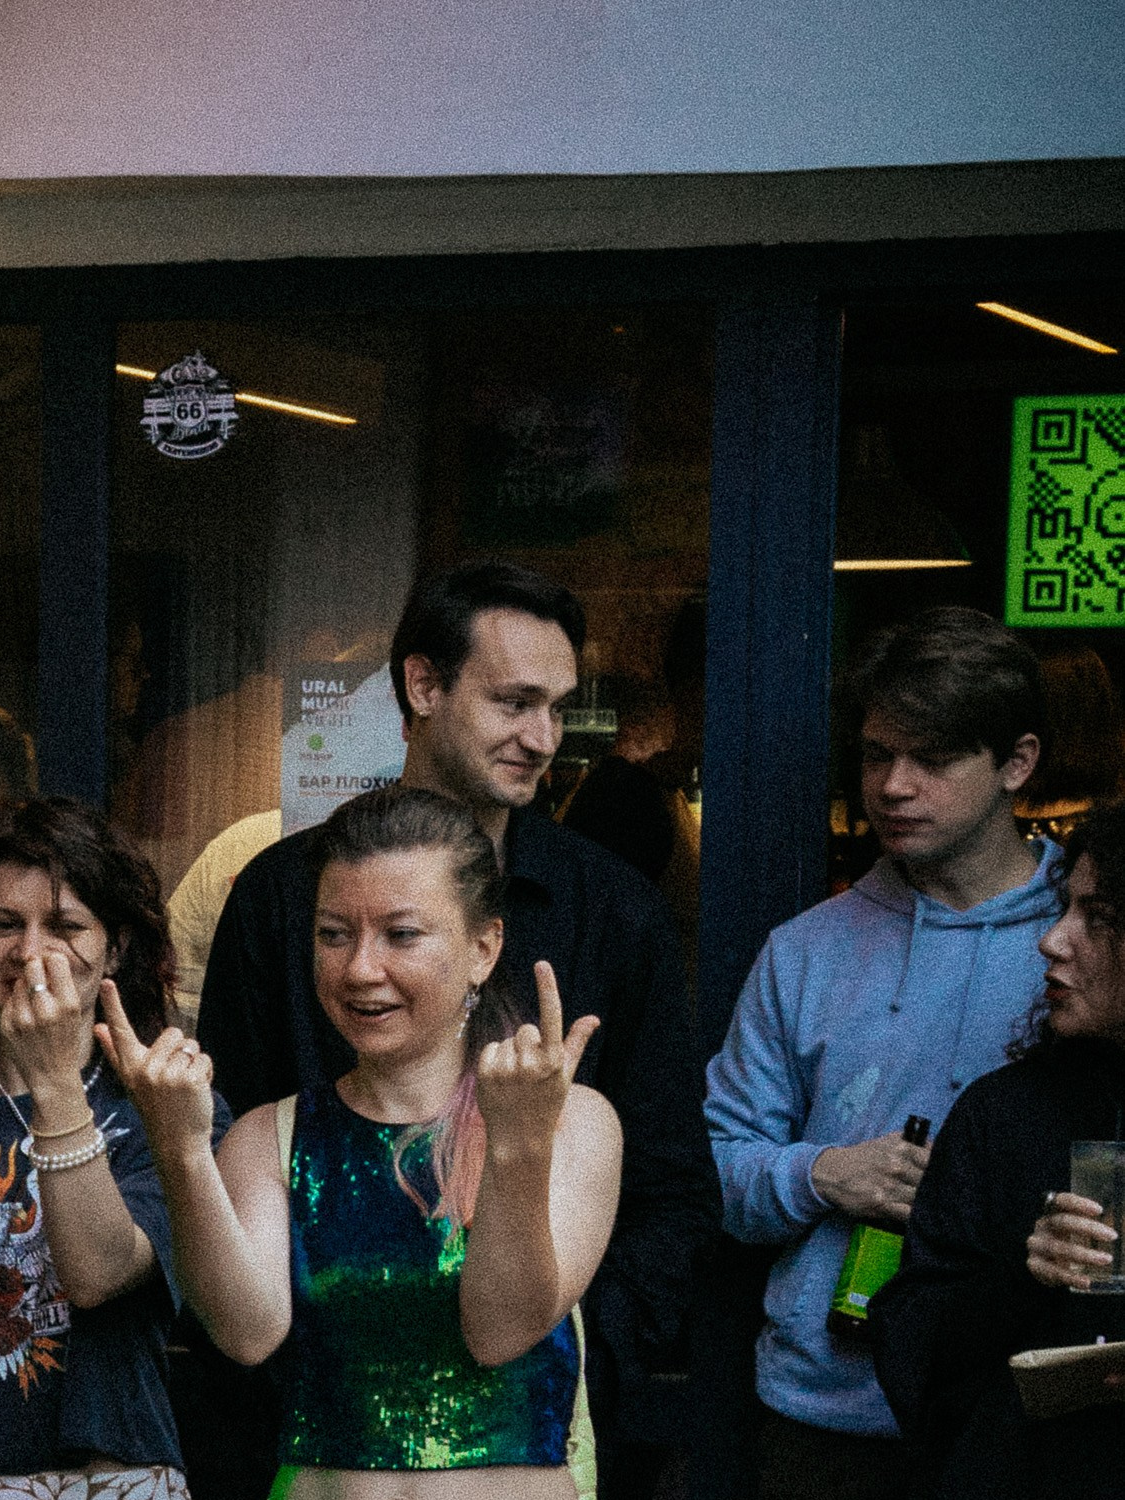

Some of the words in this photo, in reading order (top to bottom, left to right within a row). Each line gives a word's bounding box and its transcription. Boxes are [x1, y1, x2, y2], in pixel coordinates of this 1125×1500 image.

[177, 404, 201, 419] 66
[301, 679, 347, 694] URAL
[301, 696, 356, 711] MUSIC
[299, 776, 330, 788] БАР
